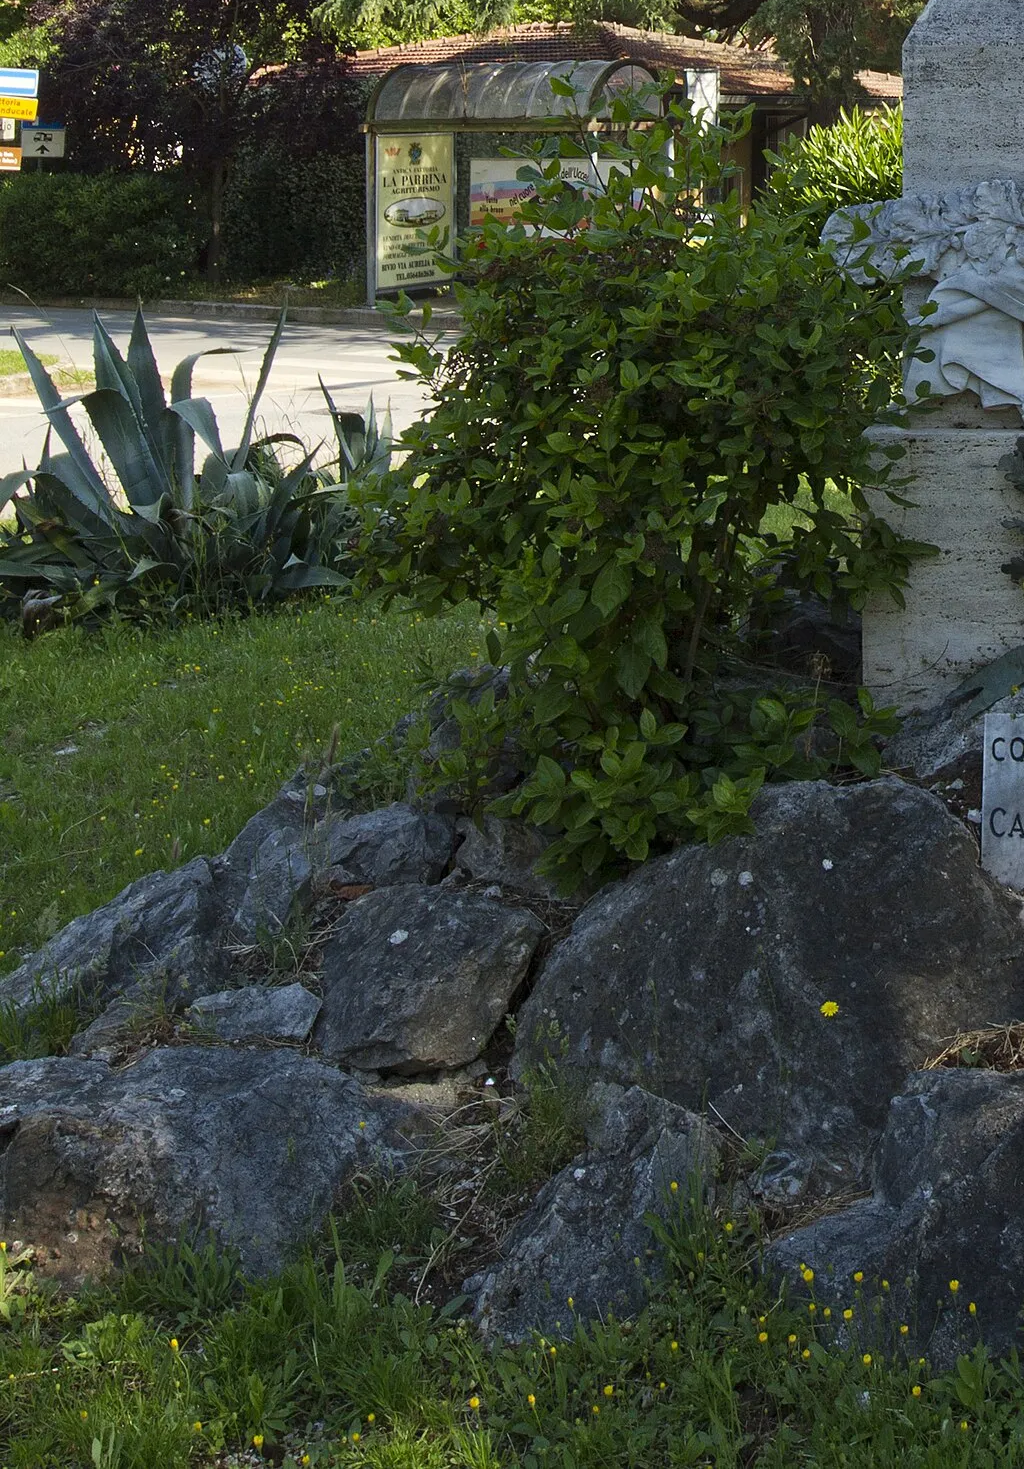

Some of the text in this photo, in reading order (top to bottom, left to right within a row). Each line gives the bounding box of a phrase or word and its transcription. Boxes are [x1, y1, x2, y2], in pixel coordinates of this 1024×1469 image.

[383, 173, 447, 188] LA PARRINA
[392, 185, 441, 195] AGRITURISMO
[509, 183, 535, 207] nel cuore
[398, 261, 407, 270] VIA
[408, 259, 431, 269] AURELIA
